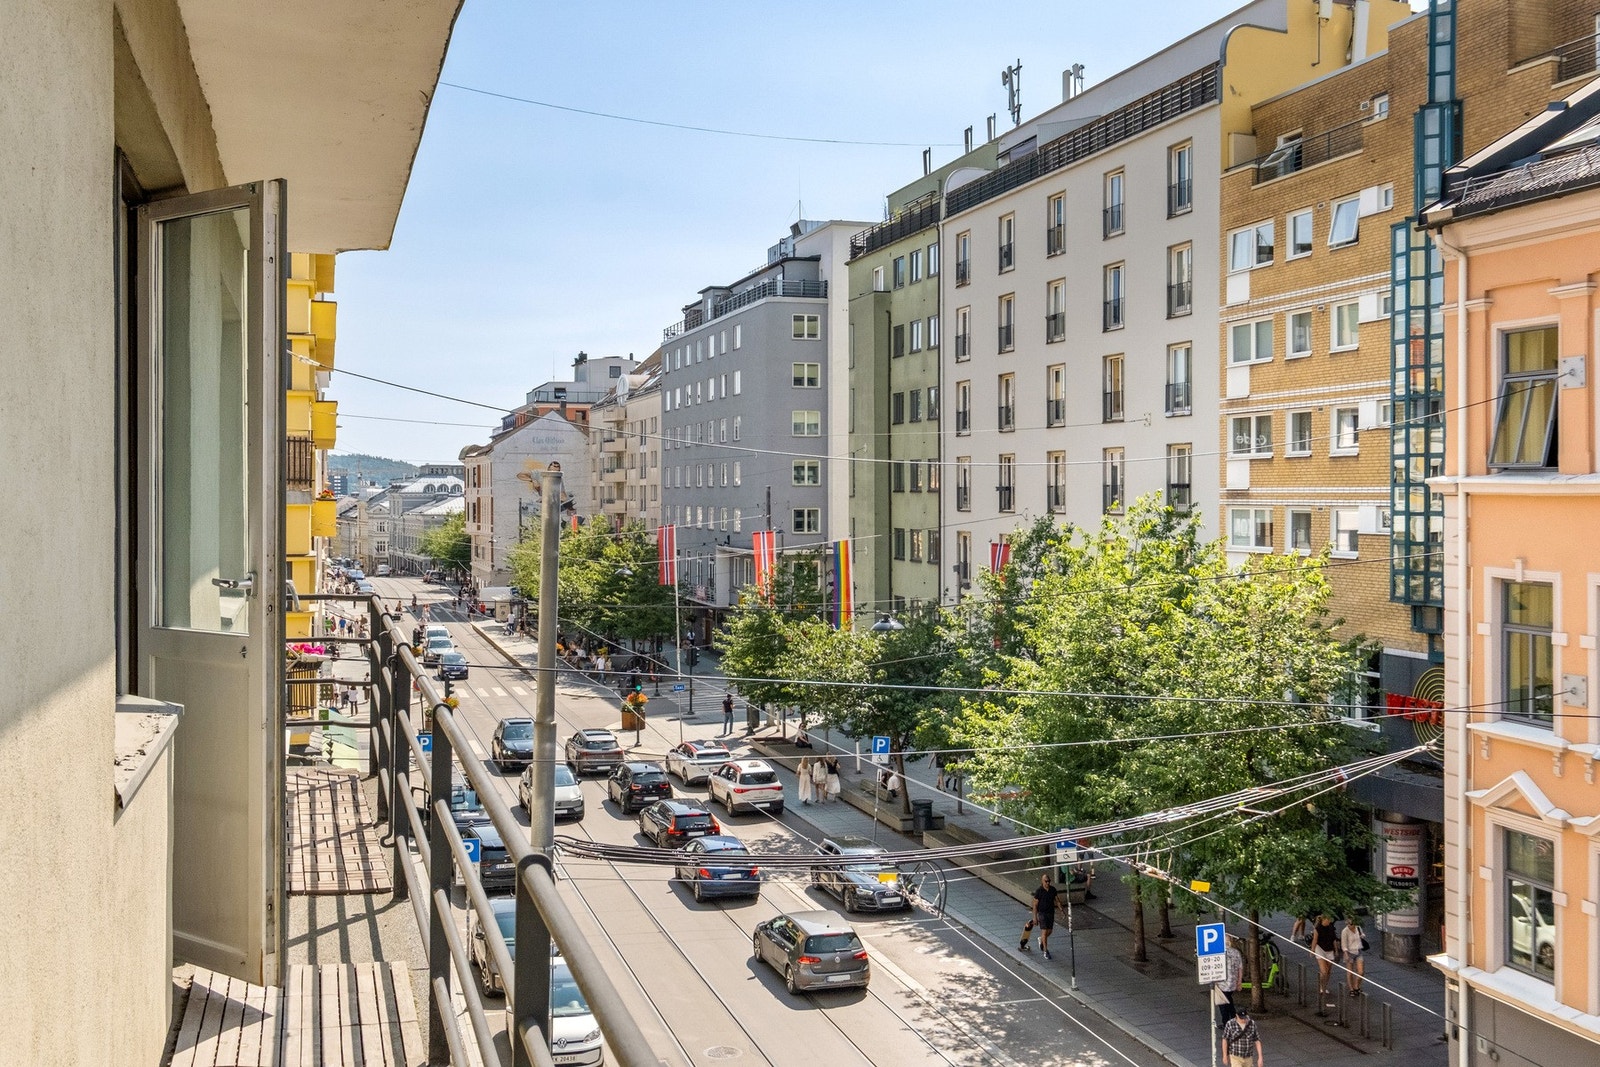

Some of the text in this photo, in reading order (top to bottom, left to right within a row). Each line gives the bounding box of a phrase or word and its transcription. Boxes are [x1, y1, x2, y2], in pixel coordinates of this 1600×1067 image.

[1386, 693, 1444, 726] WEST
[876, 738, 886, 752] P
[1384, 828, 1419, 836] WESTSIDE
[1203, 928, 1218, 952] P
